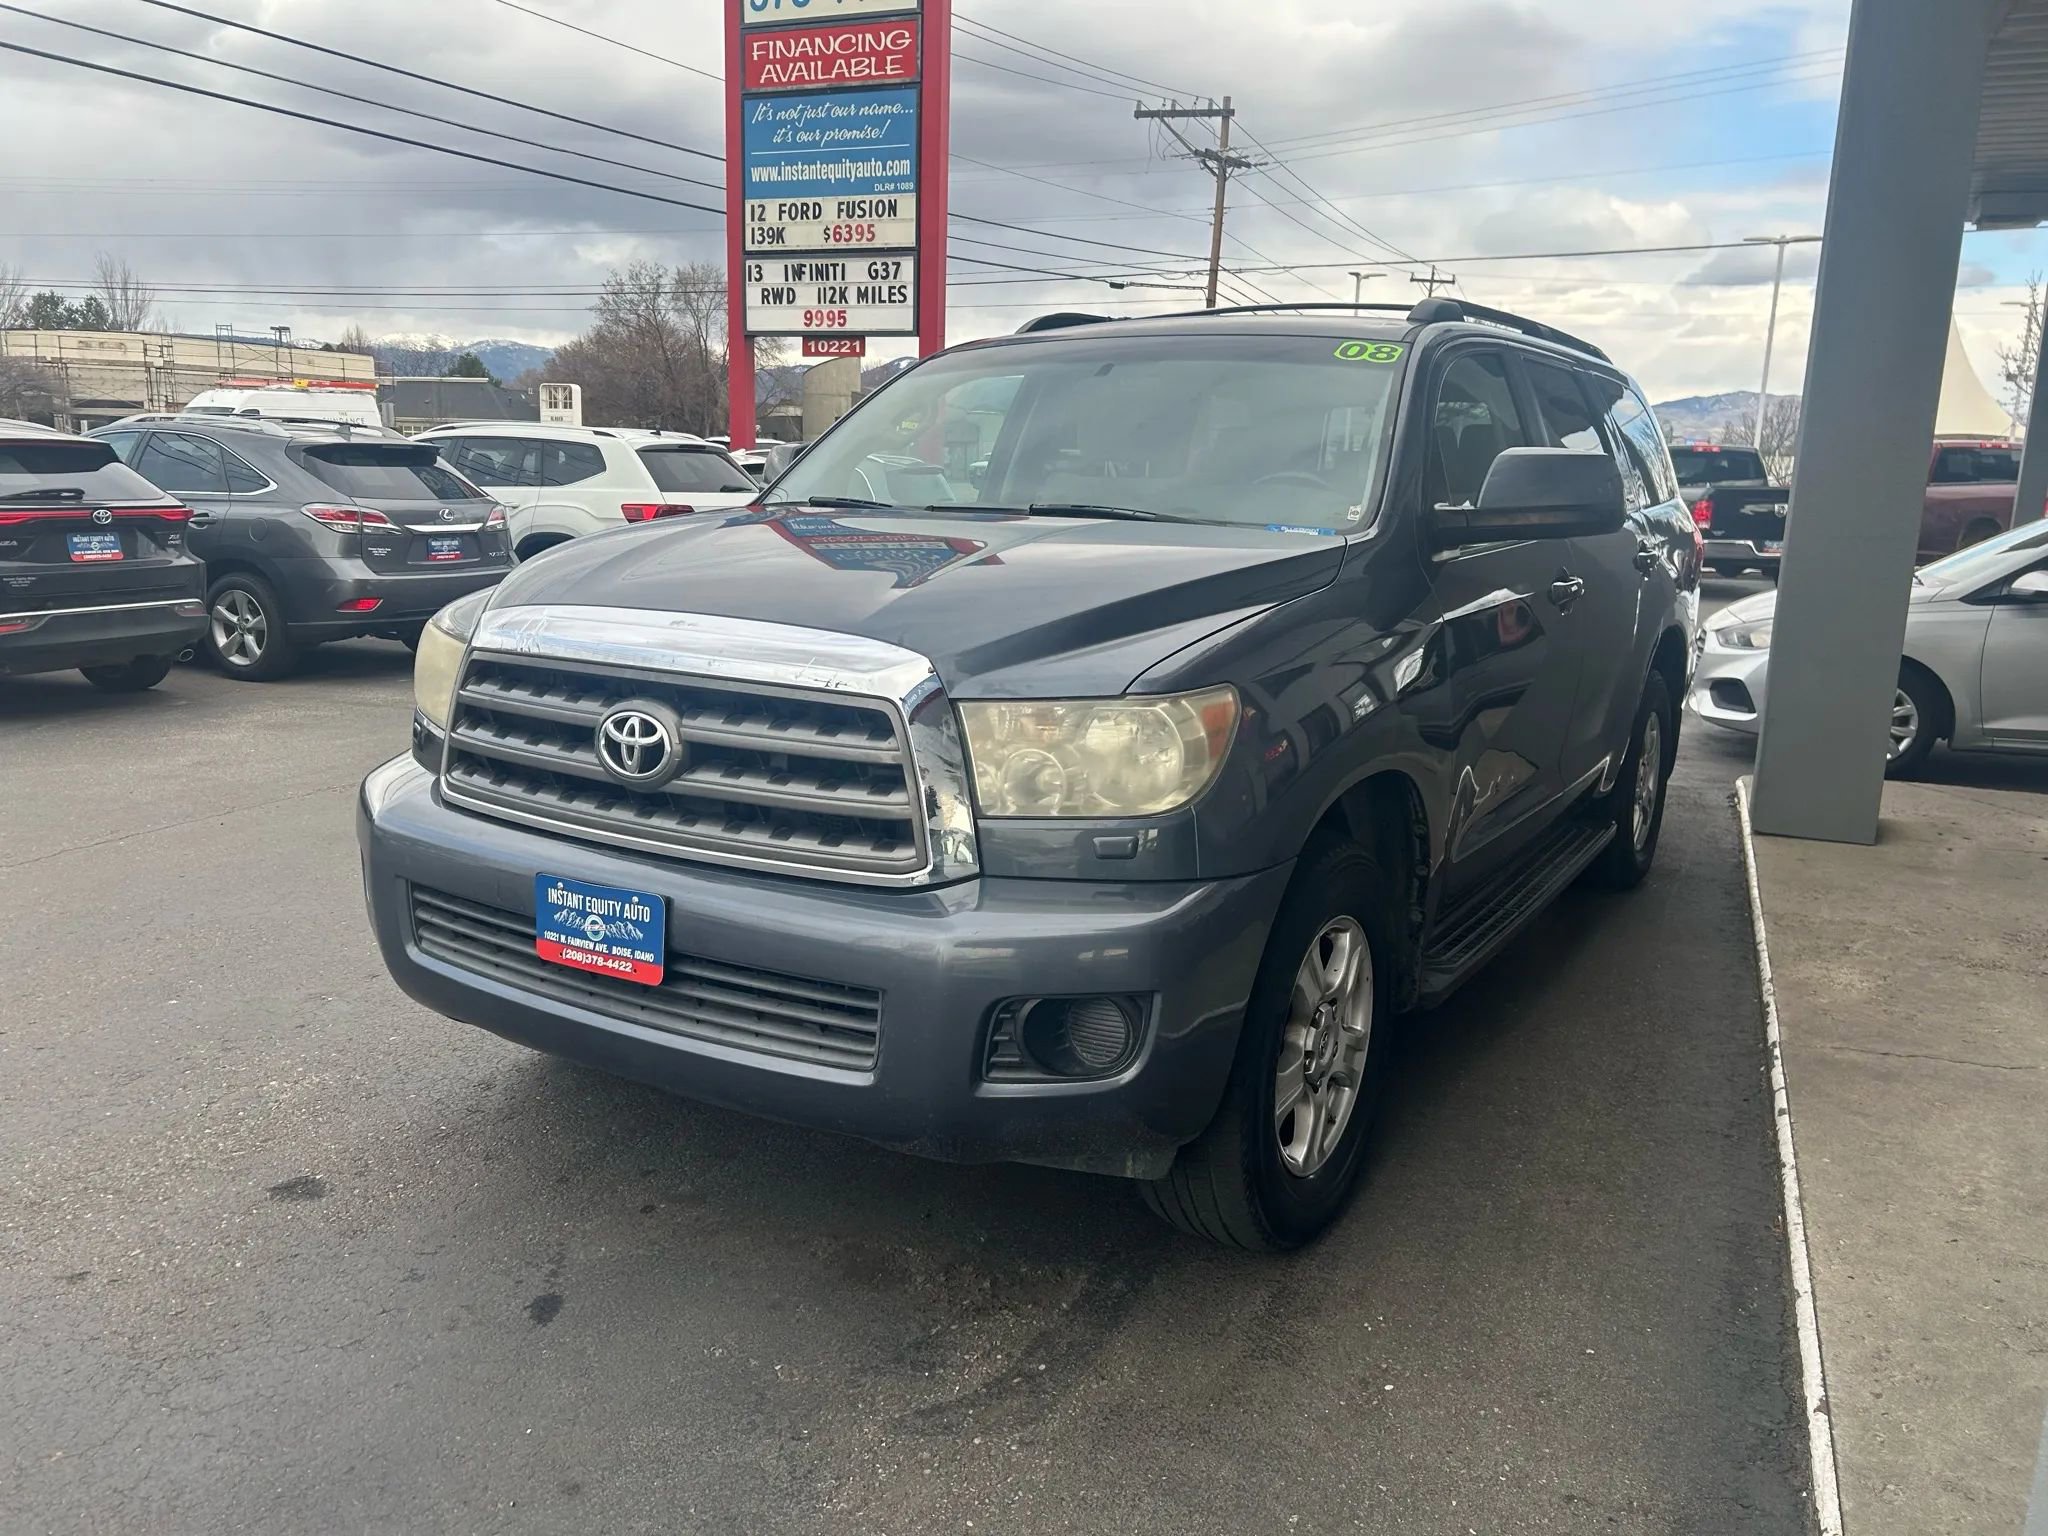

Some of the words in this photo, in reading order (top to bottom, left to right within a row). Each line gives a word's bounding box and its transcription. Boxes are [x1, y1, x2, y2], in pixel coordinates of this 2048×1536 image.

[752, 30, 912, 61] FINANCING
[759, 55, 904, 84] AVAILABLE
[752, 102, 773, 124] It's
[776, 103, 803, 121] not
[796, 102, 830, 127] just
[831, 104, 856, 117] our
[859, 102, 914, 116] name...
[773, 124, 793, 144] it's
[797, 129, 821, 143] our
[820, 119, 891, 148] promise!
[751, 157, 911, 184] www.instantequityauto.com
[874, 183, 895, 192] DLR#
[896, 182, 914, 191] 1089
[750, 204, 766, 222] 12
[778, 202, 822, 221] FORD
[837, 199, 898, 219] FUSION
[751, 227, 786, 245] 139K
[823, 224, 876, 243] $6395
[748, 264, 763, 282] 13
[784, 263, 846, 282] INFINITI
[867, 261, 901, 281] G37
[761, 287, 796, 305] RWD
[817, 286, 849, 305] 112K
[856, 285, 908, 304] MILES
[803, 310, 847, 328] 9995
[807, 340, 861, 353] 10221
[1337, 341, 1401, 363] 08
[547, 887, 583, 911] INSTANT
[586, 897, 621, 917] EQUITY
[624, 903, 651, 923] AUTO
[544, 930, 560, 942] 10221
[567, 936, 595, 951] FAIRVIEW
[634, 951, 655, 963] IDAHO
[562, 948, 632, 973] (208)378-4422
